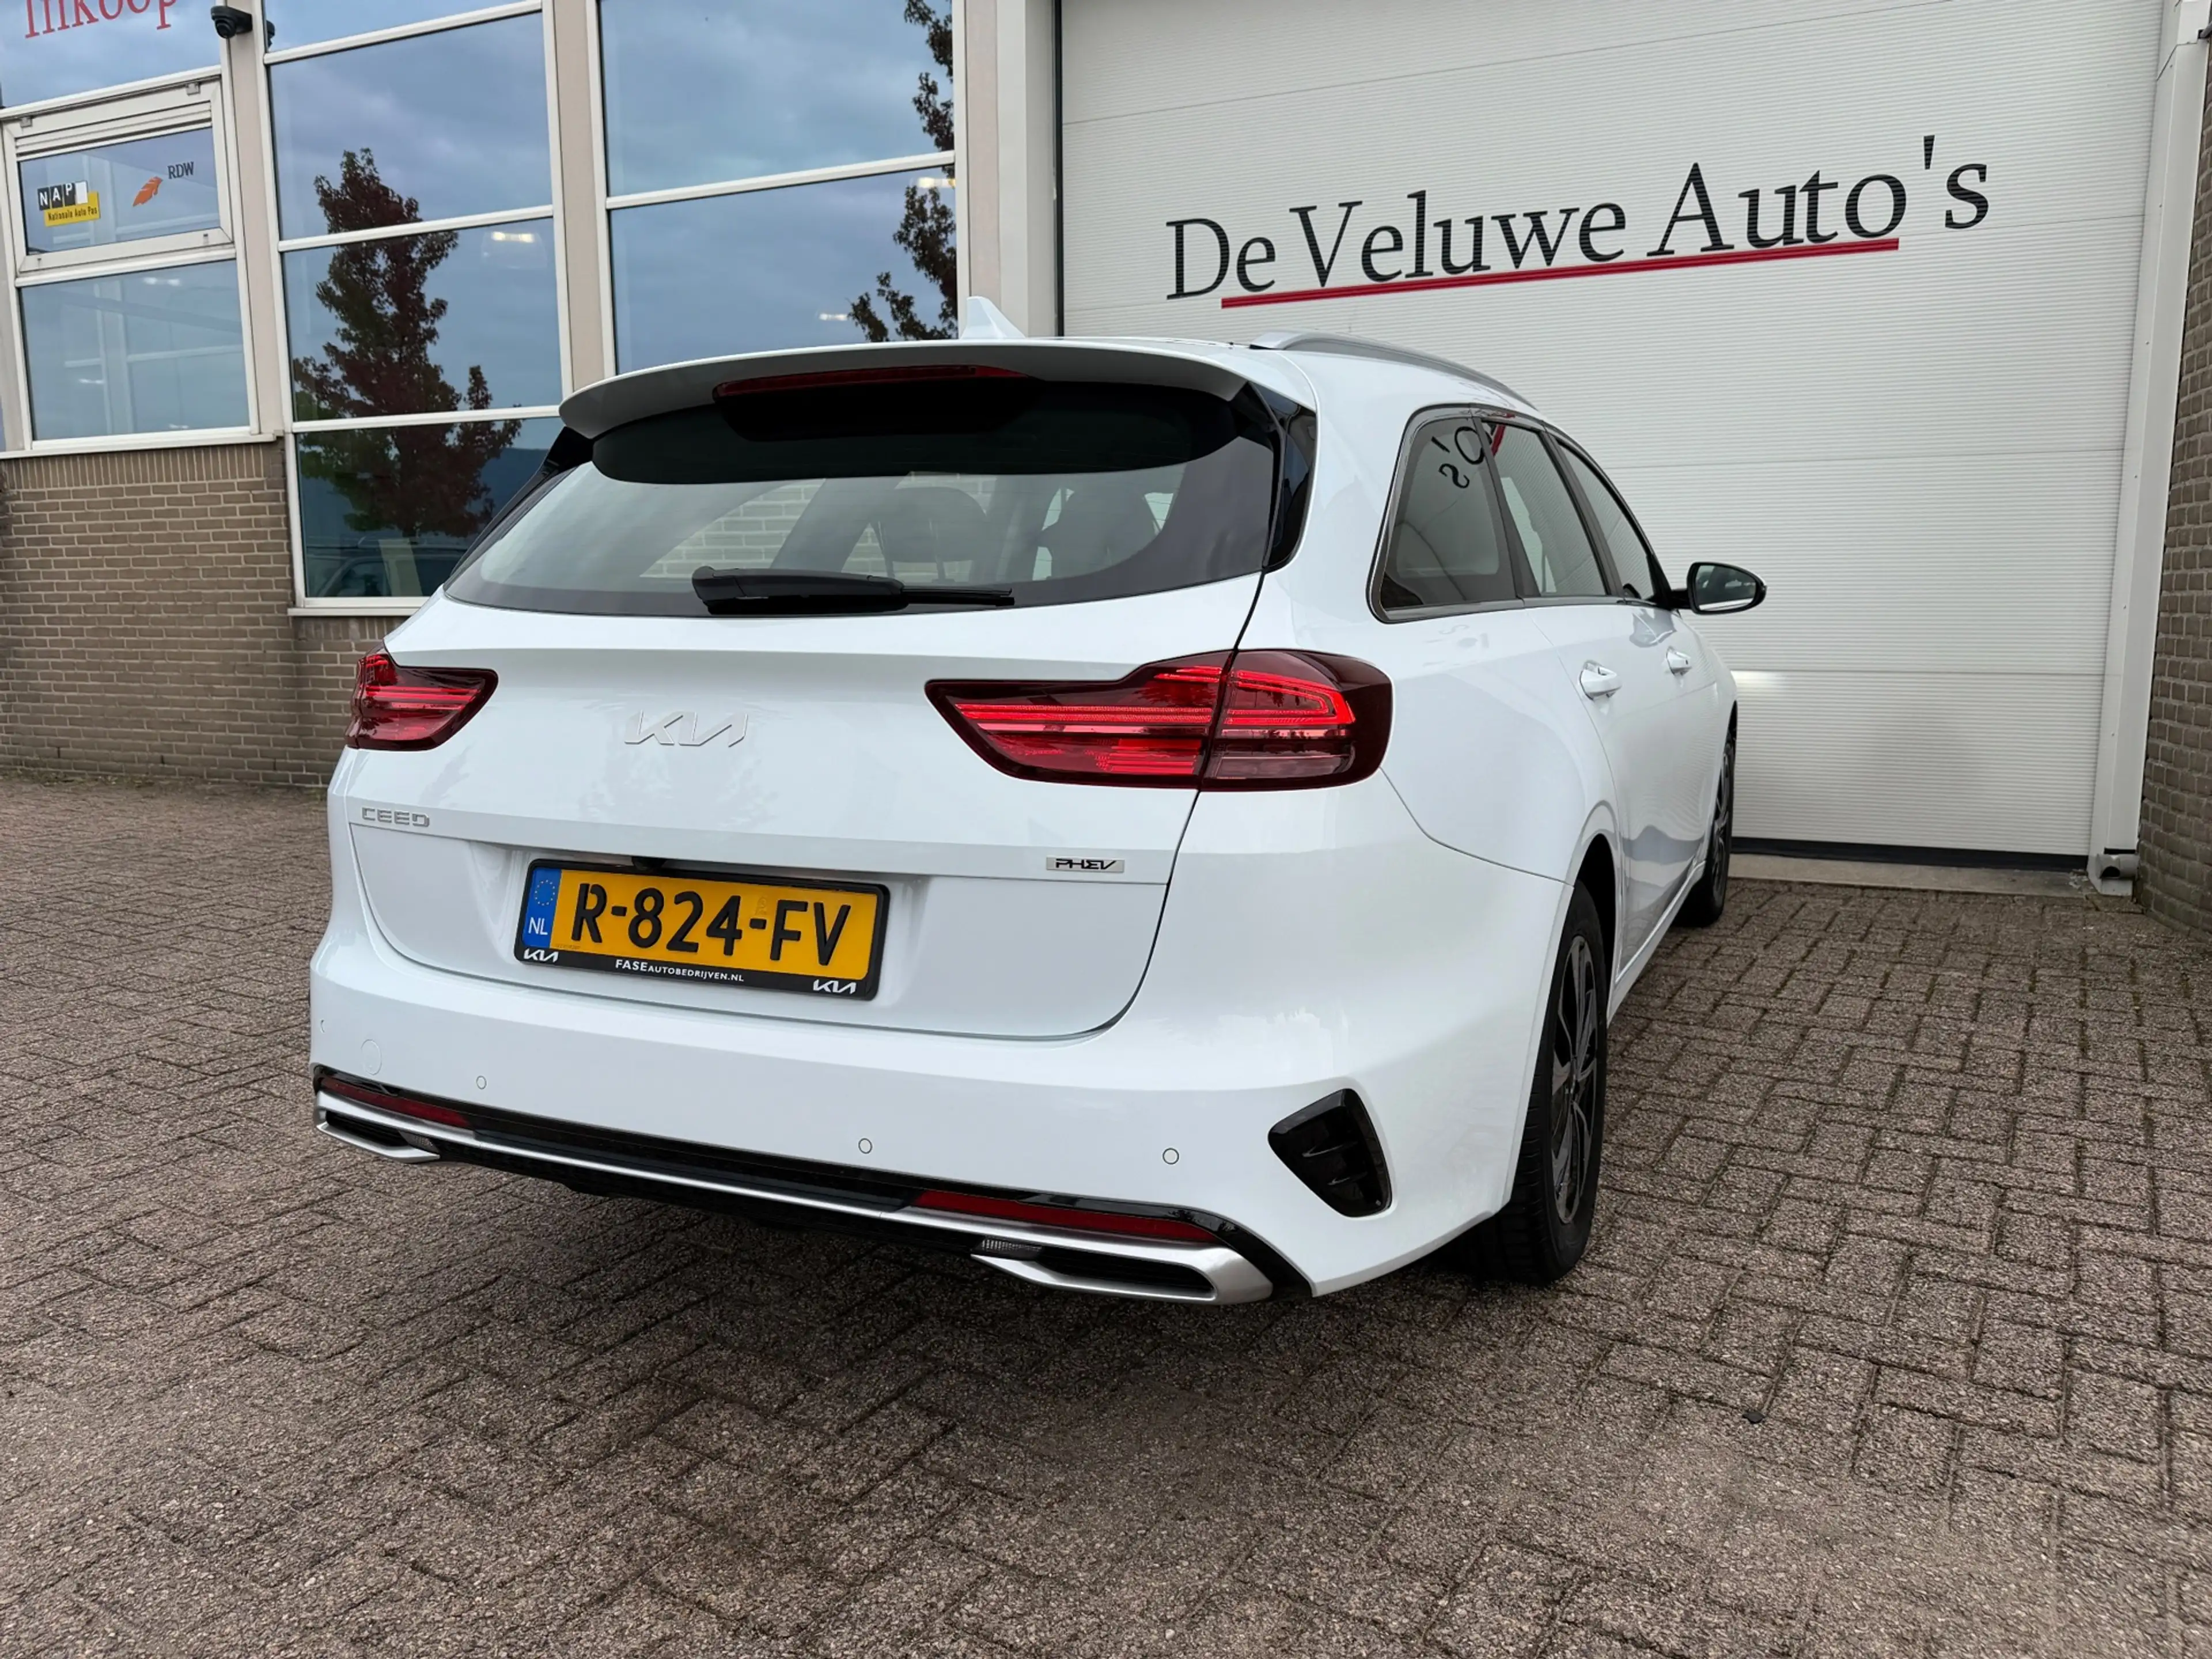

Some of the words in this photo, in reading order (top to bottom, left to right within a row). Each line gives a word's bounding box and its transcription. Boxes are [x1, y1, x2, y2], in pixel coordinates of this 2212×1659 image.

[167, 161, 194, 180] RDW
[39, 183, 73, 207] NAP
[87, 206, 97, 215] Pas
[1166, 218, 1276, 300] De
[1289, 190, 1626, 288] Veluwe
[1646, 134, 1990, 257] Auto's
[624, 709, 748, 748] KIA
[362, 806, 430, 828] CEED
[1055, 858, 1117, 870] PHEV
[528, 916, 548, 935] NL
[570, 882, 851, 966] R-824-FV
[524, 948, 559, 963] KIA
[813, 979, 856, 995] KIA
